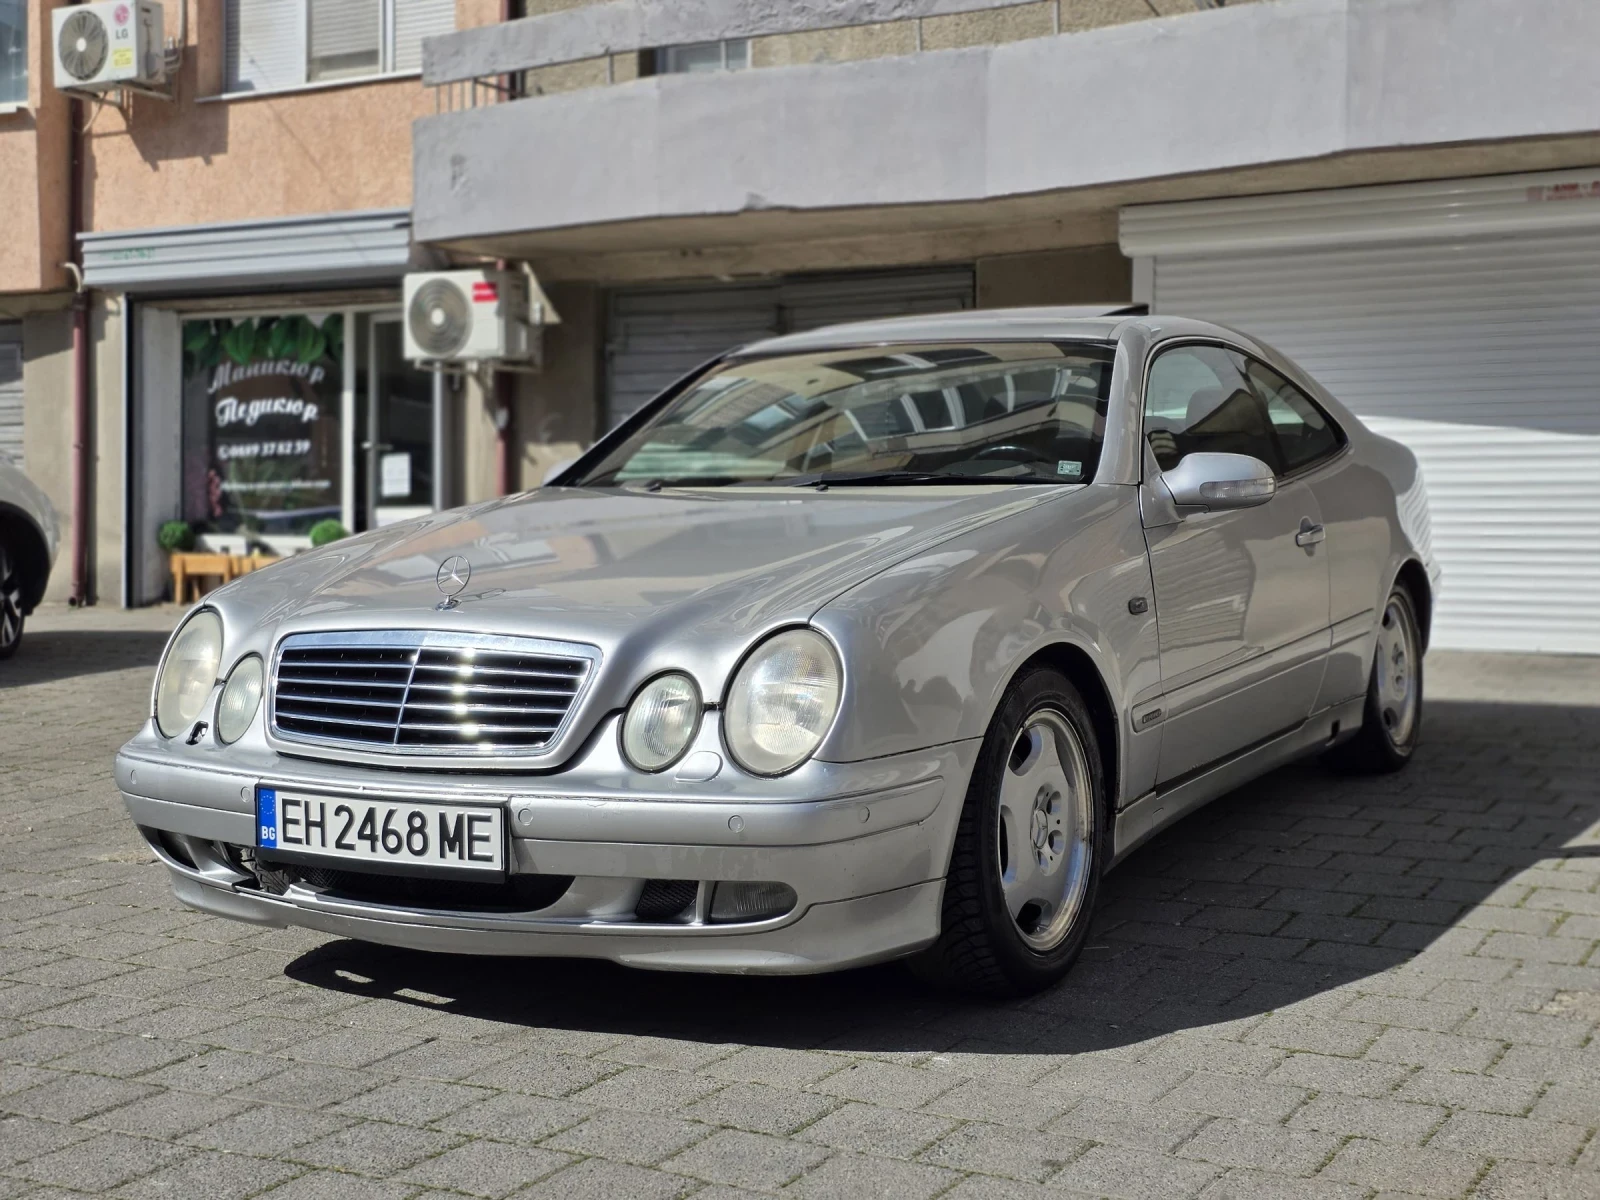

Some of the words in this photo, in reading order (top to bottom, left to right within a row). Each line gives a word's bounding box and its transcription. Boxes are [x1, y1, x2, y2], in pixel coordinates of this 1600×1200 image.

[115, 28, 129, 40] LG
[207, 360, 325, 394] Маникюр
[215, 397, 319, 427] Педикюр
[261, 825, 276, 841] BG
[282, 798, 327, 848] EH
[334, 804, 429, 857] 2468
[439, 811, 494, 863] ME
